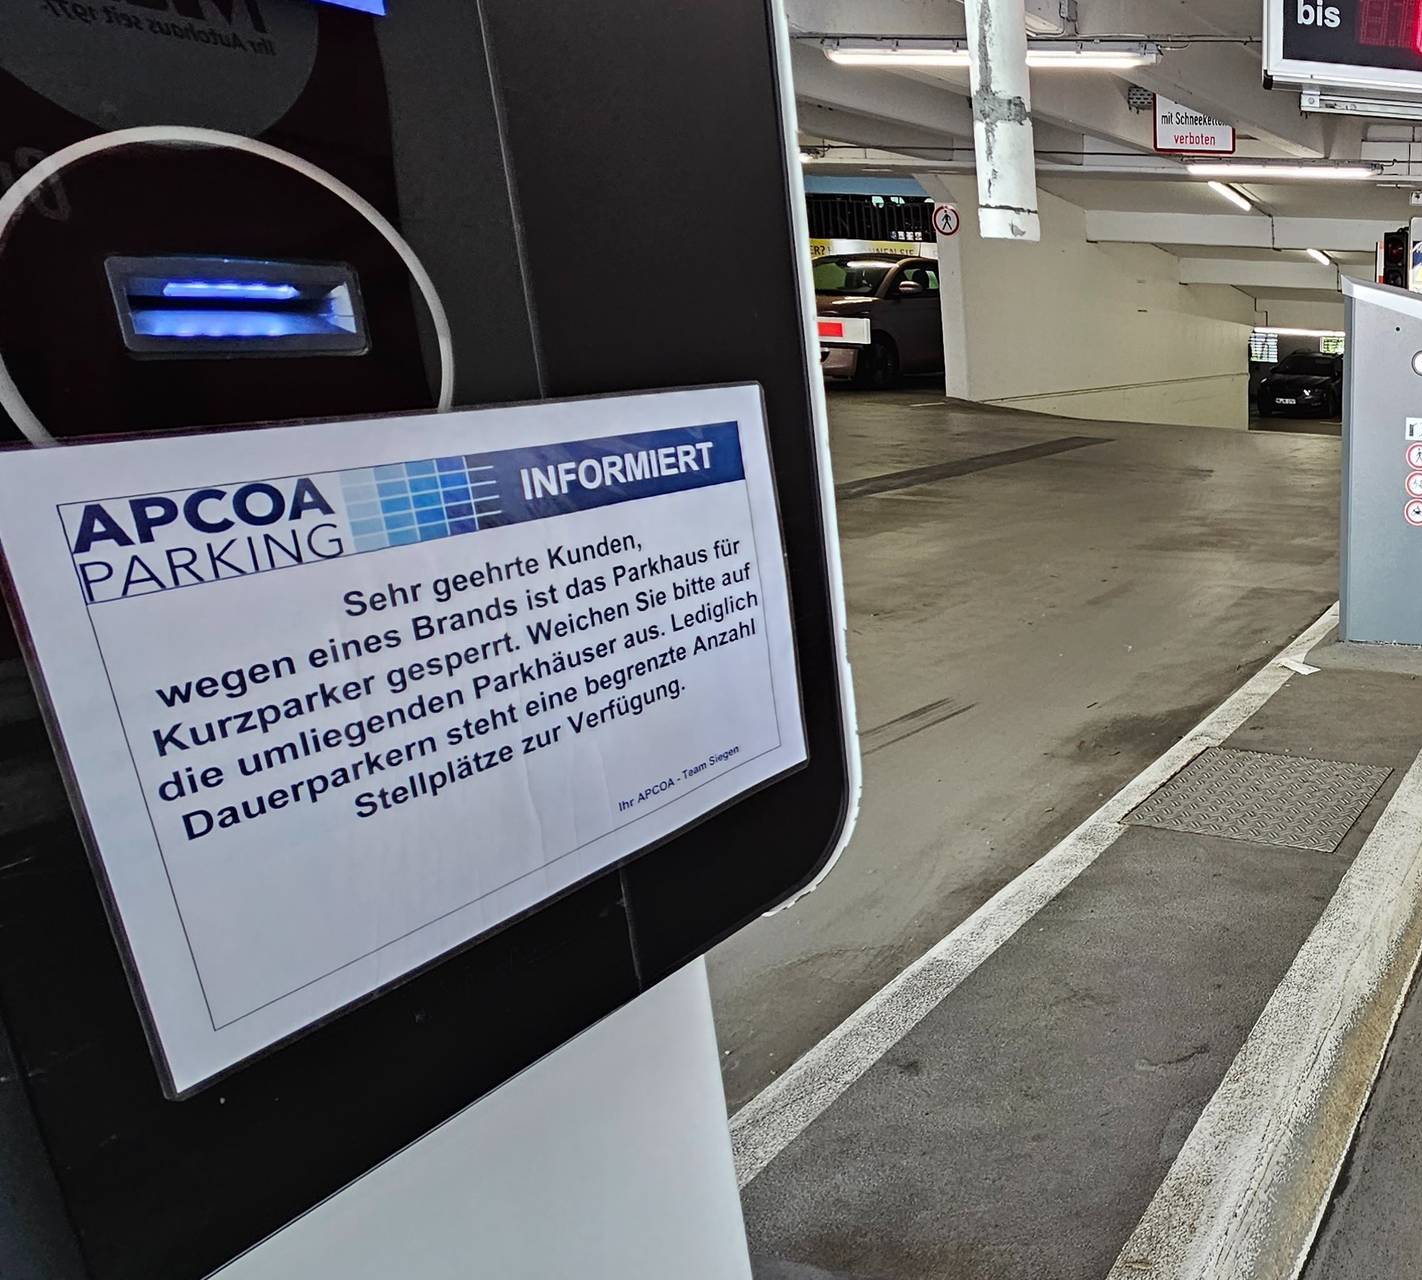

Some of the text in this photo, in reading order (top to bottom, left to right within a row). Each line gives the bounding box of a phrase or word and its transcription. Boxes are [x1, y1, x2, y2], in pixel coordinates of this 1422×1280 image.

[1297, 0, 1342, 28] bis
[1161, 112, 1226, 126] mit Schneeke
[1174, 132, 1216, 145] verboten
[520, 442, 713, 500] INFORMIERT
[73, 477, 335, 553] APCOA
[78, 523, 345, 602] PARKING
[343, 534, 642, 617] Sehr geehrte Kunden,
[153, 562, 751, 757] Kurzparker gesperrt. Weichen Sie bitte auf
[155, 538, 740, 708] wegen eines Brands ist das Parkhaus für
[158, 590, 758, 801] die umliegenden Parkhäuser aus. Lediglich
[182, 618, 756, 841] Dauerparkern steht eine begrenzte Anzahl
[354, 678, 686, 818] Stellplätze zur Verfügung.
[618, 798, 634, 812] Ihr
[637, 778, 676, 804] APCOA
[681, 762, 707, 780] Team
[708, 745, 740, 766] Siegen
